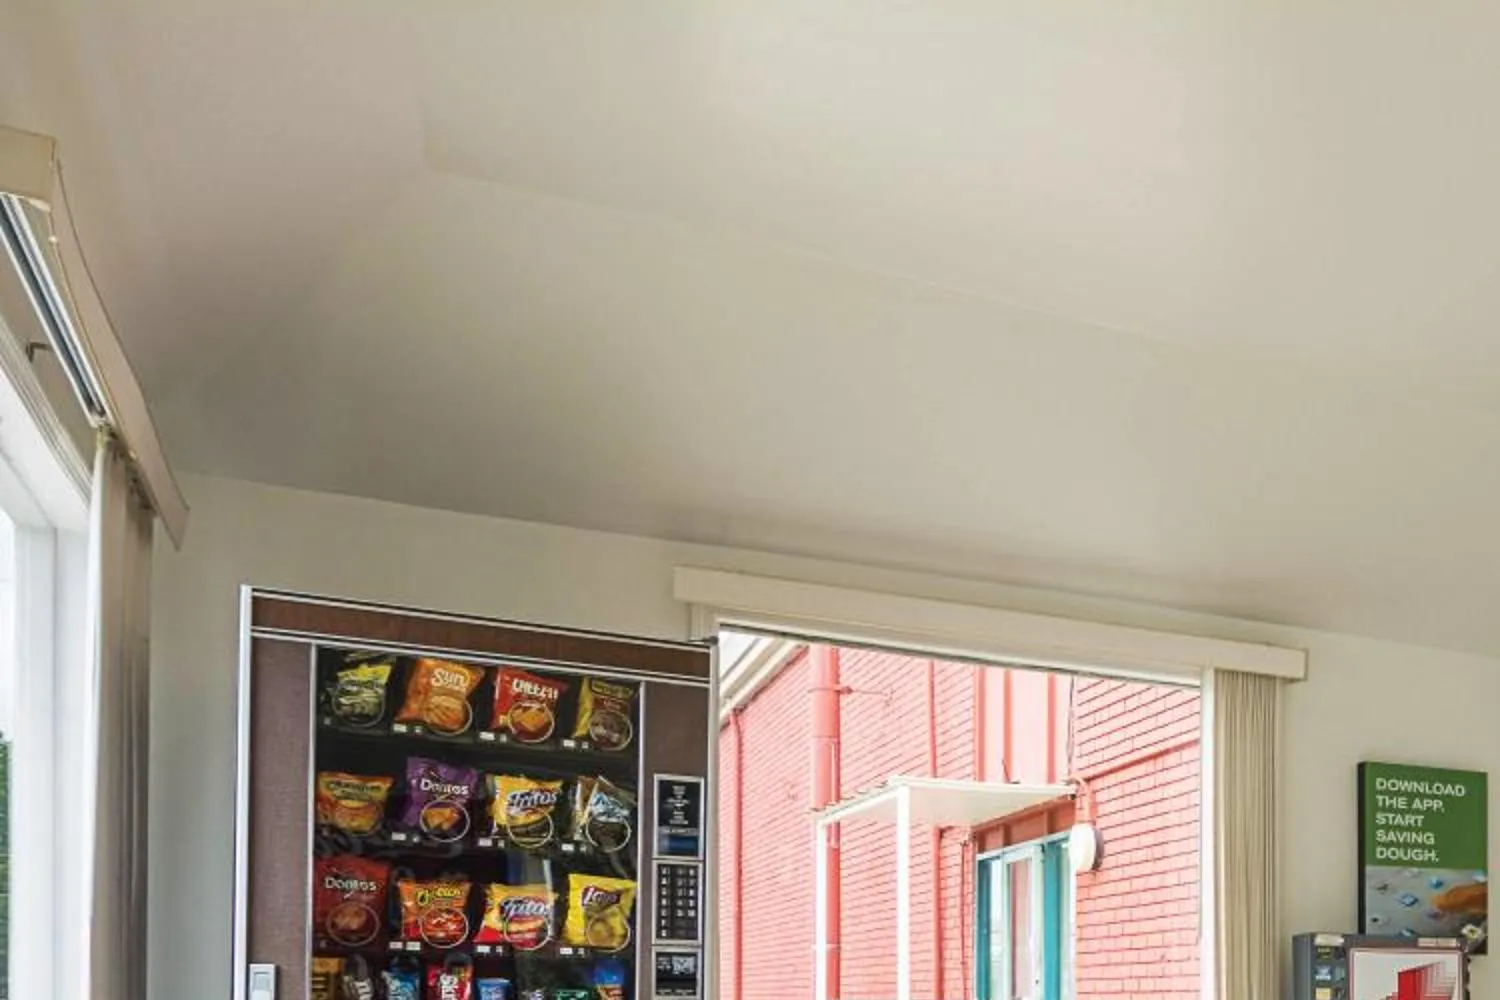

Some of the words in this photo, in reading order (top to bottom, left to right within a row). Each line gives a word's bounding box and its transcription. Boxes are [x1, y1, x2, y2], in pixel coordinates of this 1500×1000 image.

[420, 777, 469, 795] Doritos
[1376, 777, 1465, 797] DOWNLOAD
[508, 790, 557, 809] Fritos
[1376, 795, 1408, 809] THE
[1376, 812, 1424, 827] START
[1376, 829, 1435, 845] SAVING
[1376, 846, 1439, 862] DOUGH.
[324, 876, 377, 891] Doritos
